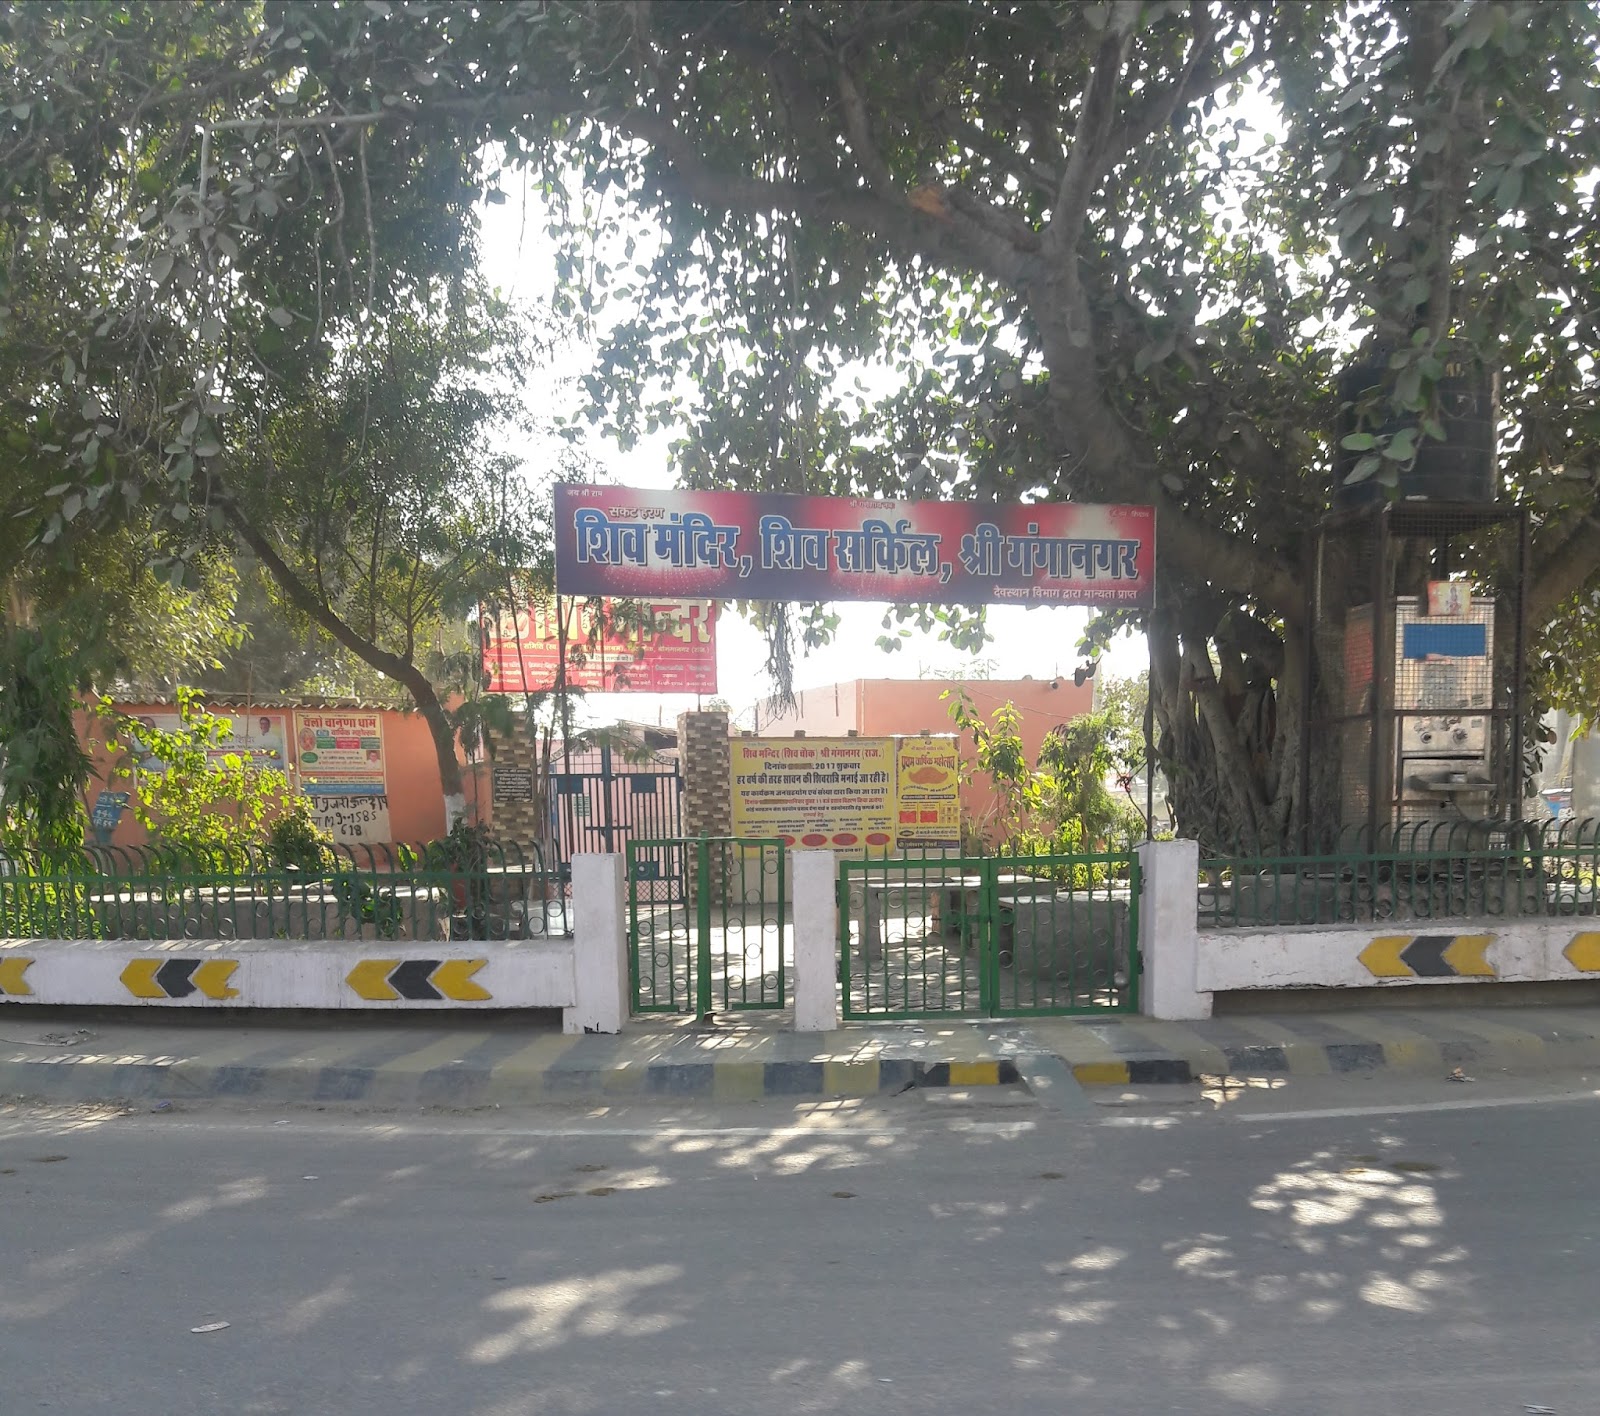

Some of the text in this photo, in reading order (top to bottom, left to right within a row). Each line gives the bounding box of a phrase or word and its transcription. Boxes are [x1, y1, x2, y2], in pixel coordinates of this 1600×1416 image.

[567, 489, 579, 497] जय
[581, 488, 589, 497] श्री
[608, 505, 666, 519] संकट हरण
[574, 508, 1142, 584] शिव मंदिर, शिव सर्किल, श्री गंगानगर
[993, 586, 1028, 599] देवस्थान
[1063, 589, 1081, 599] द्वारा
[1084, 589, 1115, 599] मान्यता
[1118, 589, 1138, 599] प्राप्त
[303, 715, 323, 728] चलो
[358, 718, 376, 728] धाम
[743, 746, 885, 760] शिव मन्दिर (शिव चौक) श्री गंगानगर (राज.)
[764, 761, 787, 771] दिनांक
[736, 775, 746, 785] हर
[746, 773, 757, 784] वर्ष
[757, 772, 768, 784] की
[768, 775, 782, 784] तरह
[783, 775, 801, 784] सावन
[802, 772, 812, 784] की
[813, 772, 840, 784] शिवरात्रि
[840, 771, 858, 784] मनाई
[859, 774, 868, 783] जा
[869, 772, 880, 783] रही
[808, 788, 817, 796] एवं
[817, 788, 833, 796] संस्था
[341, 824, 362, 836] 618
